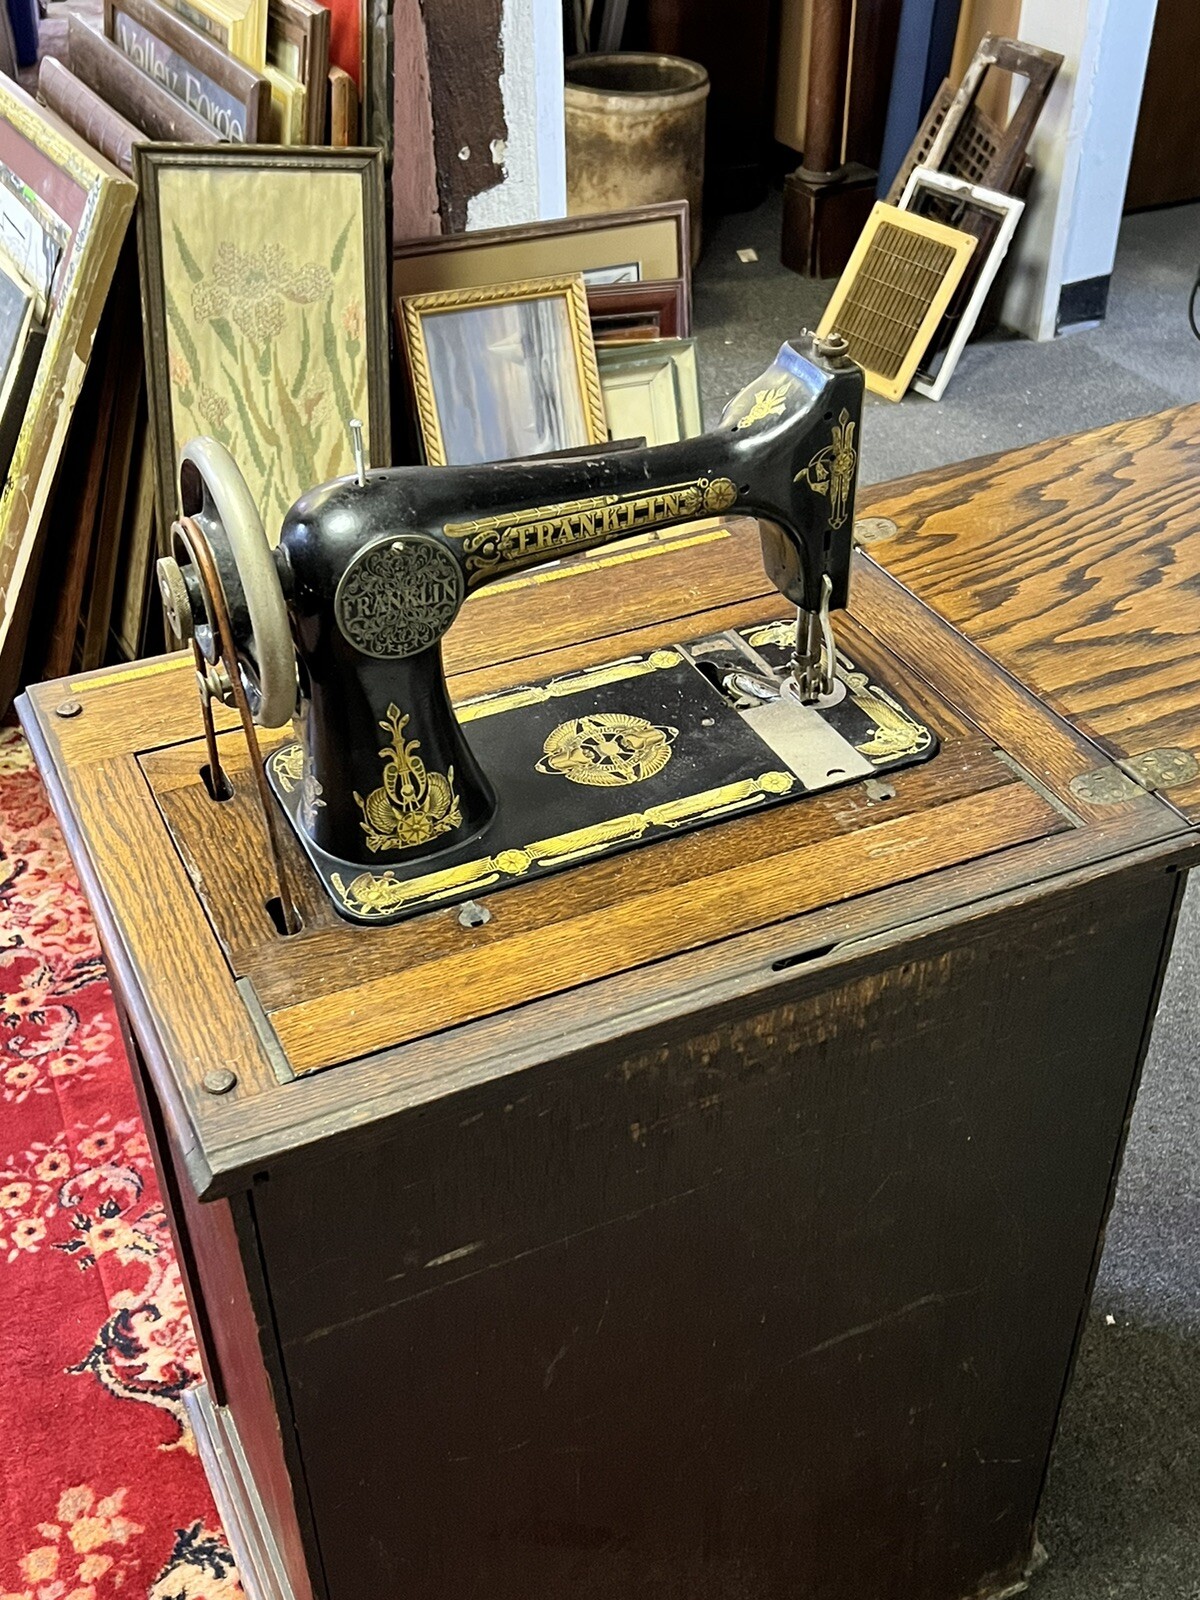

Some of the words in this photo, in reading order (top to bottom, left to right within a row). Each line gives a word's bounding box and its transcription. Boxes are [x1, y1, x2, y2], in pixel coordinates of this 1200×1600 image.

[121, 24, 178, 91] Valley
[517, 492, 681, 551] FRANKLIN
[341, 579, 458, 621] FRANKLIN
